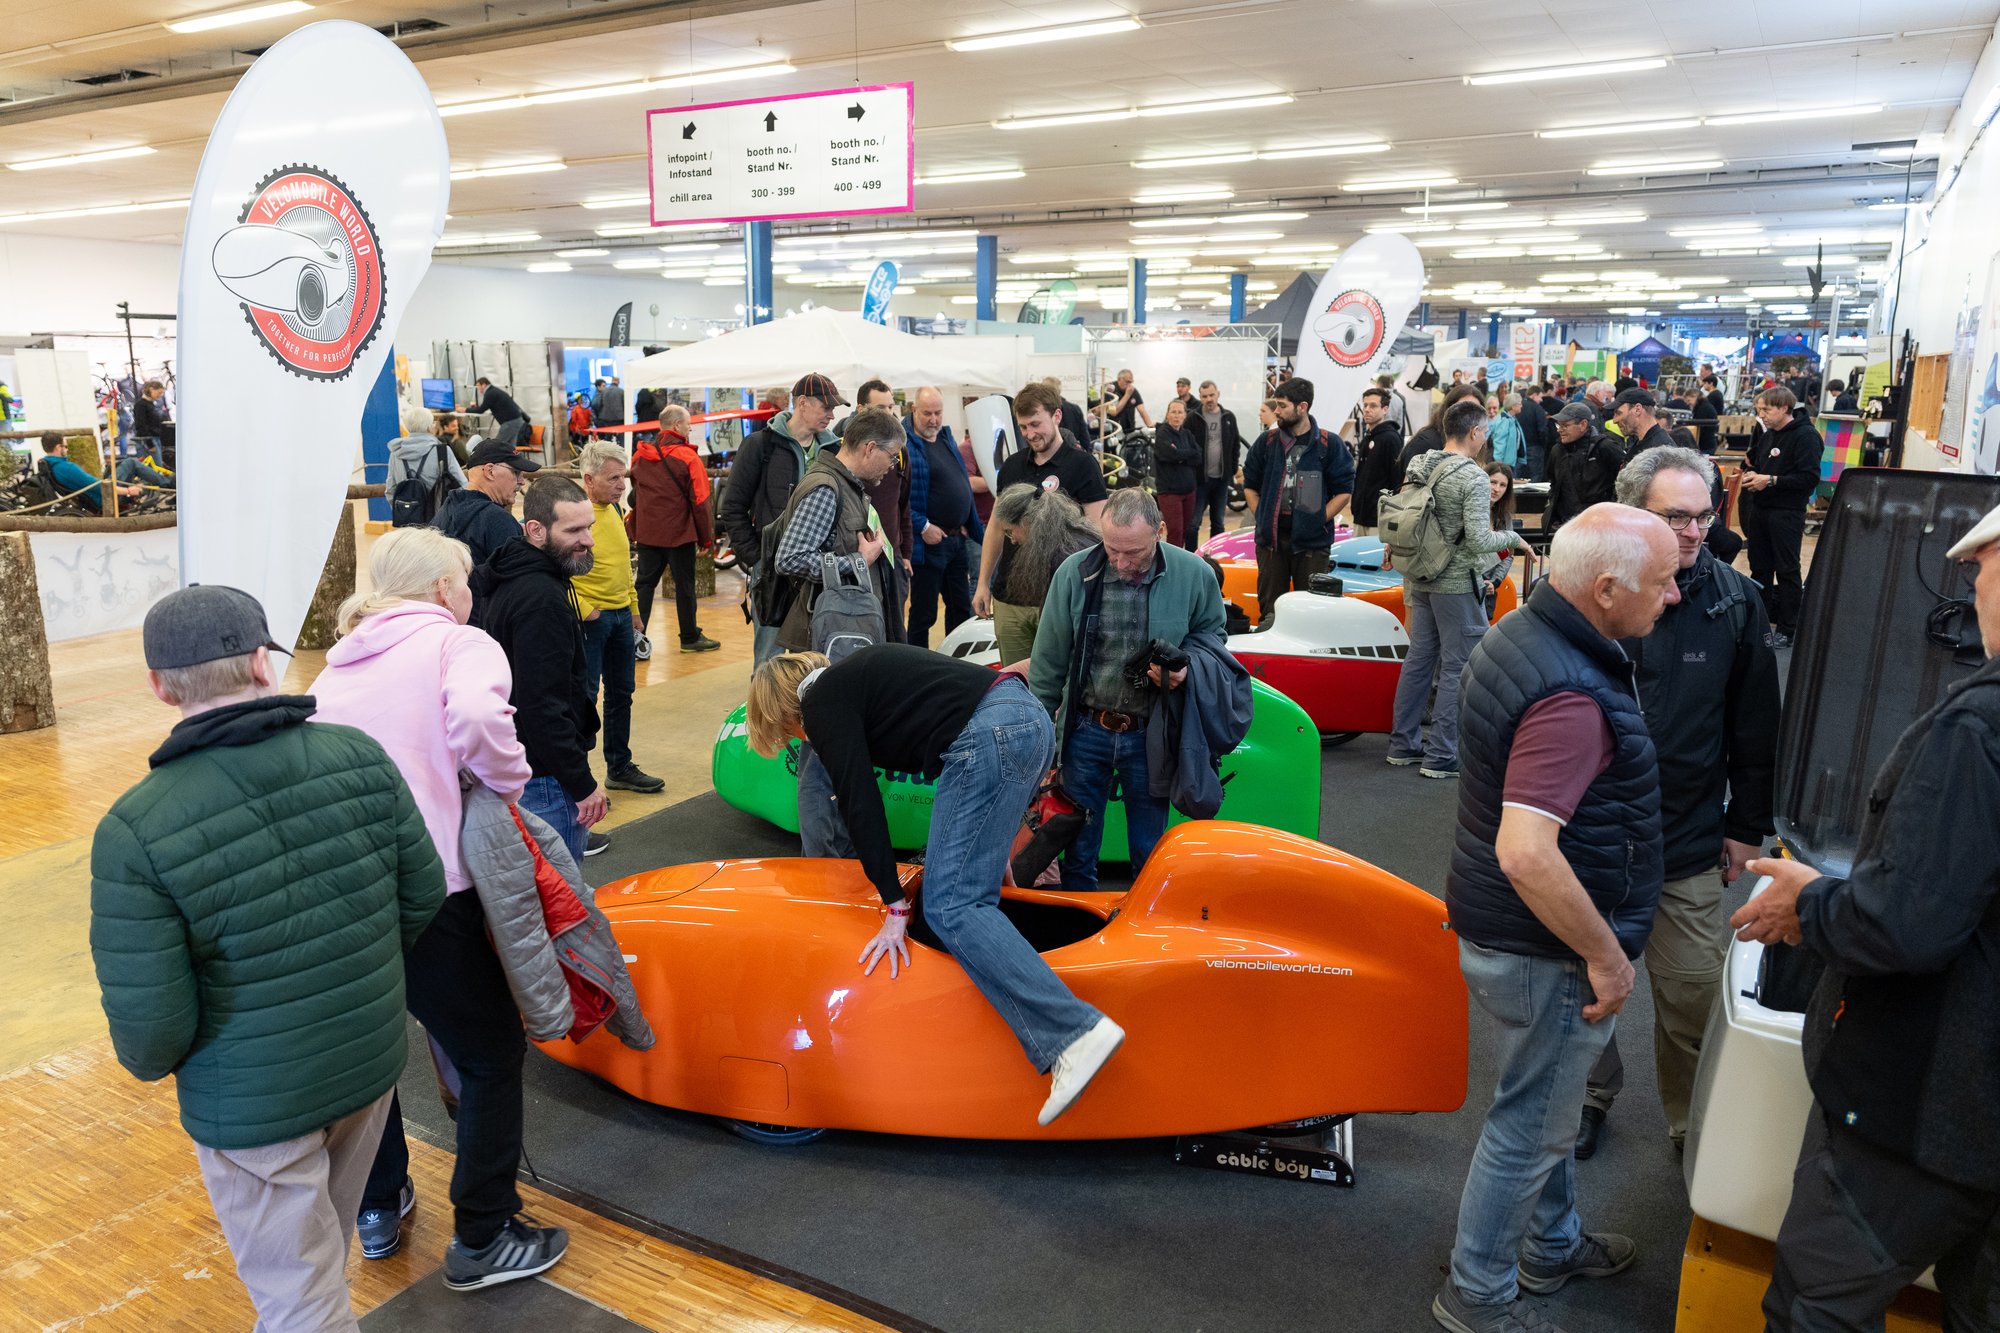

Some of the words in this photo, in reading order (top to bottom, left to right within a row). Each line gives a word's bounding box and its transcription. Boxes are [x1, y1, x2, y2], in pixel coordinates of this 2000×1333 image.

[830, 138, 860, 149] booth
[864, 137, 879, 146] no.
[746, 146, 774, 157] booth
[777, 146, 792, 155] no.
[667, 152, 707, 164] infopoint
[831, 155, 861, 166] Stand
[864, 154, 879, 163] Nr.
[669, 167, 712, 179] Infostand
[747, 162, 775, 173] Stand
[778, 161, 793, 171] Nr.
[751, 188, 769, 198] 300
[777, 186, 795, 197] 399
[834, 182, 853, 192] 400
[862, 180, 882, 190] 499
[669, 193, 690, 203] chill
[691, 192, 713, 202] area
[260, 181, 339, 220] VELOMOBILE
[339, 202, 371, 256] WORLD
[267, 318, 300, 356] TOGETHER
[303, 350, 320, 362] FOR
[1205, 958, 1353, 976] velomobileworld.com
